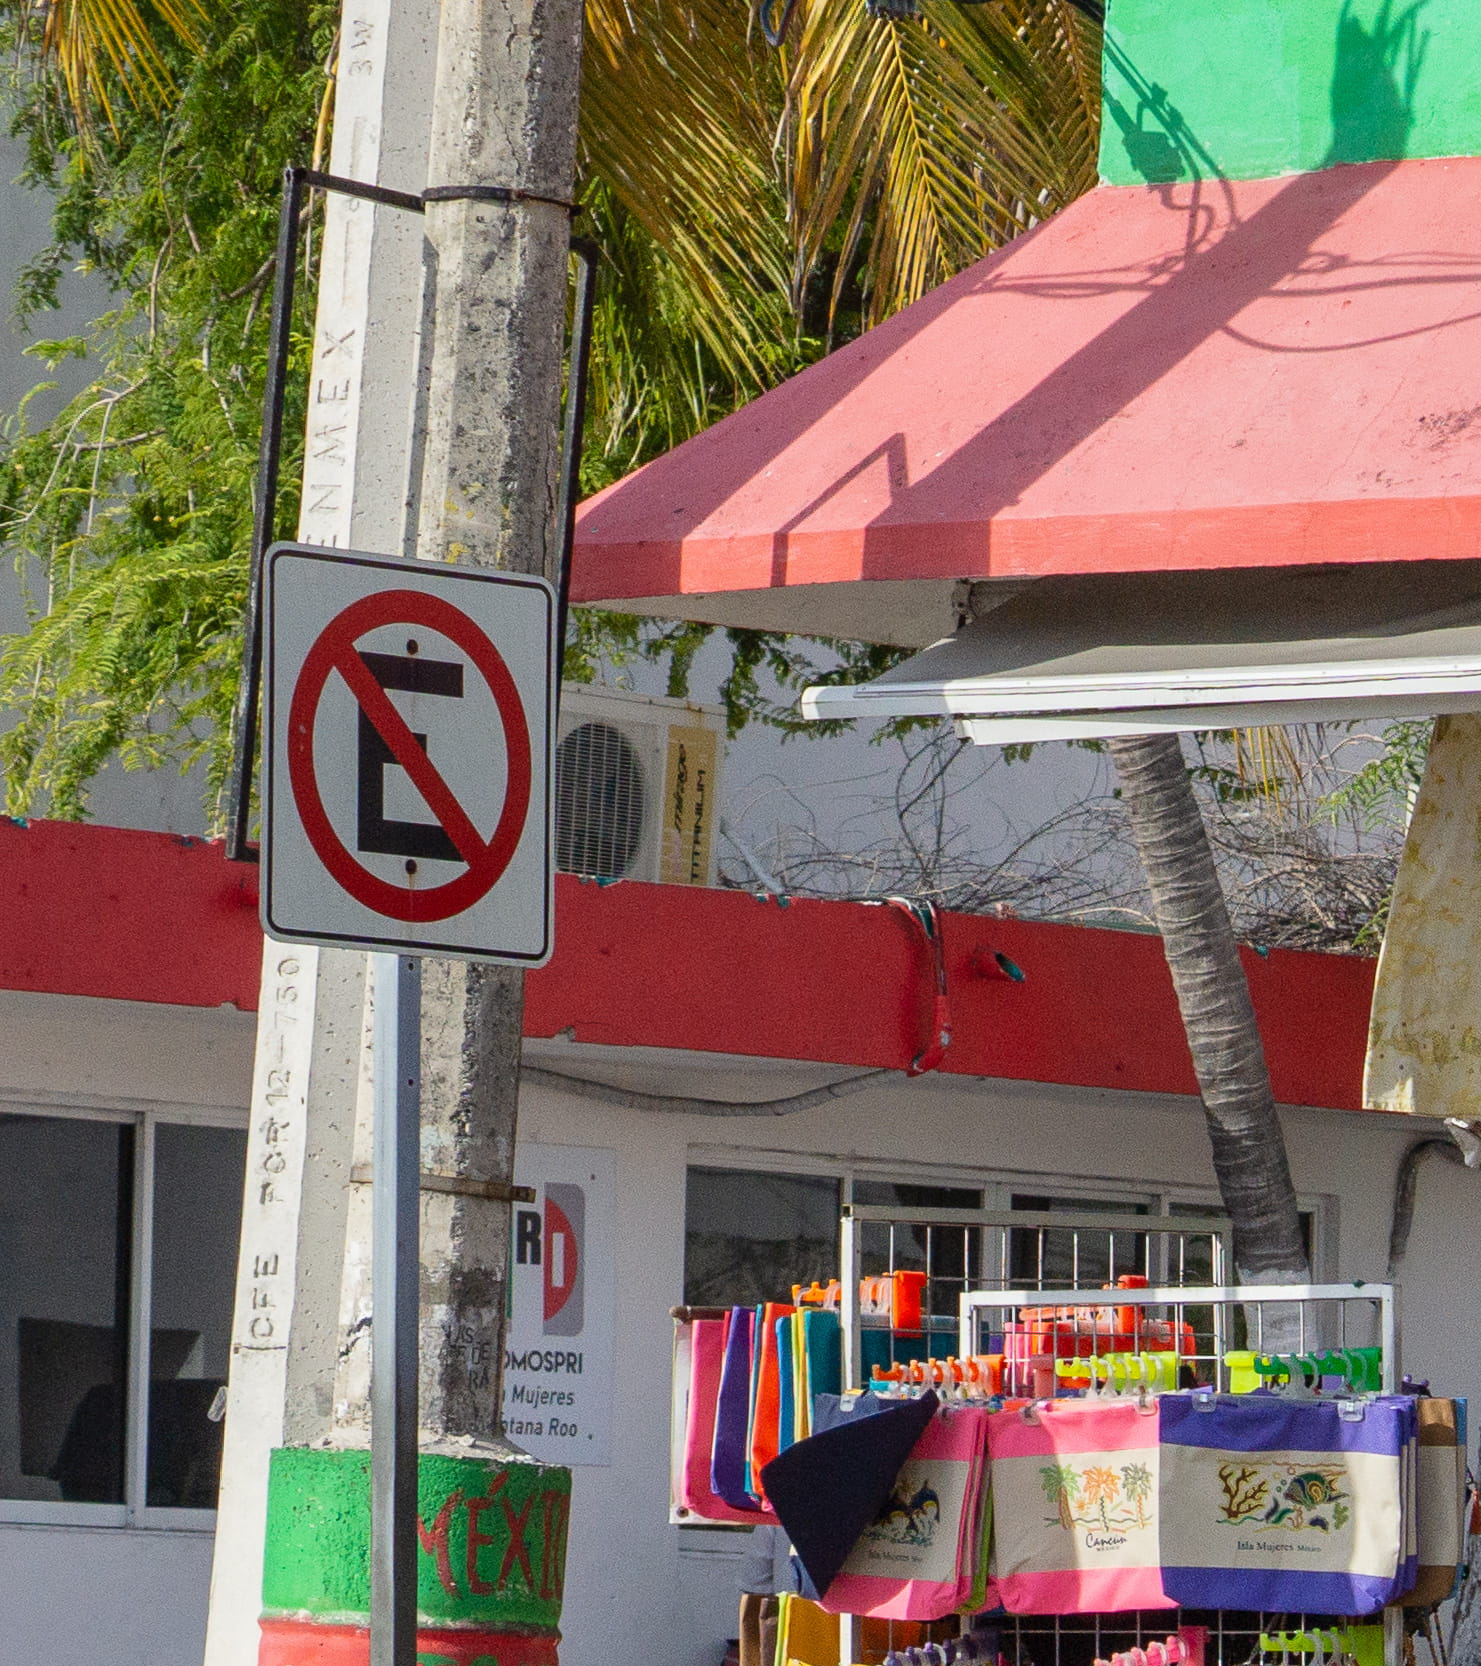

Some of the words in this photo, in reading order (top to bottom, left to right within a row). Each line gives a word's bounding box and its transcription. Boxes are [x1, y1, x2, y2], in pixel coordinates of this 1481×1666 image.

[249, 1252, 280, 1341] CFE
[511, 1385, 576, 1408] Mujeres
[547, 1420, 578, 1438] Roo
[1237, 1540, 1254, 1551] Isla
[1256, 1541, 1294, 1554] Mujeres
